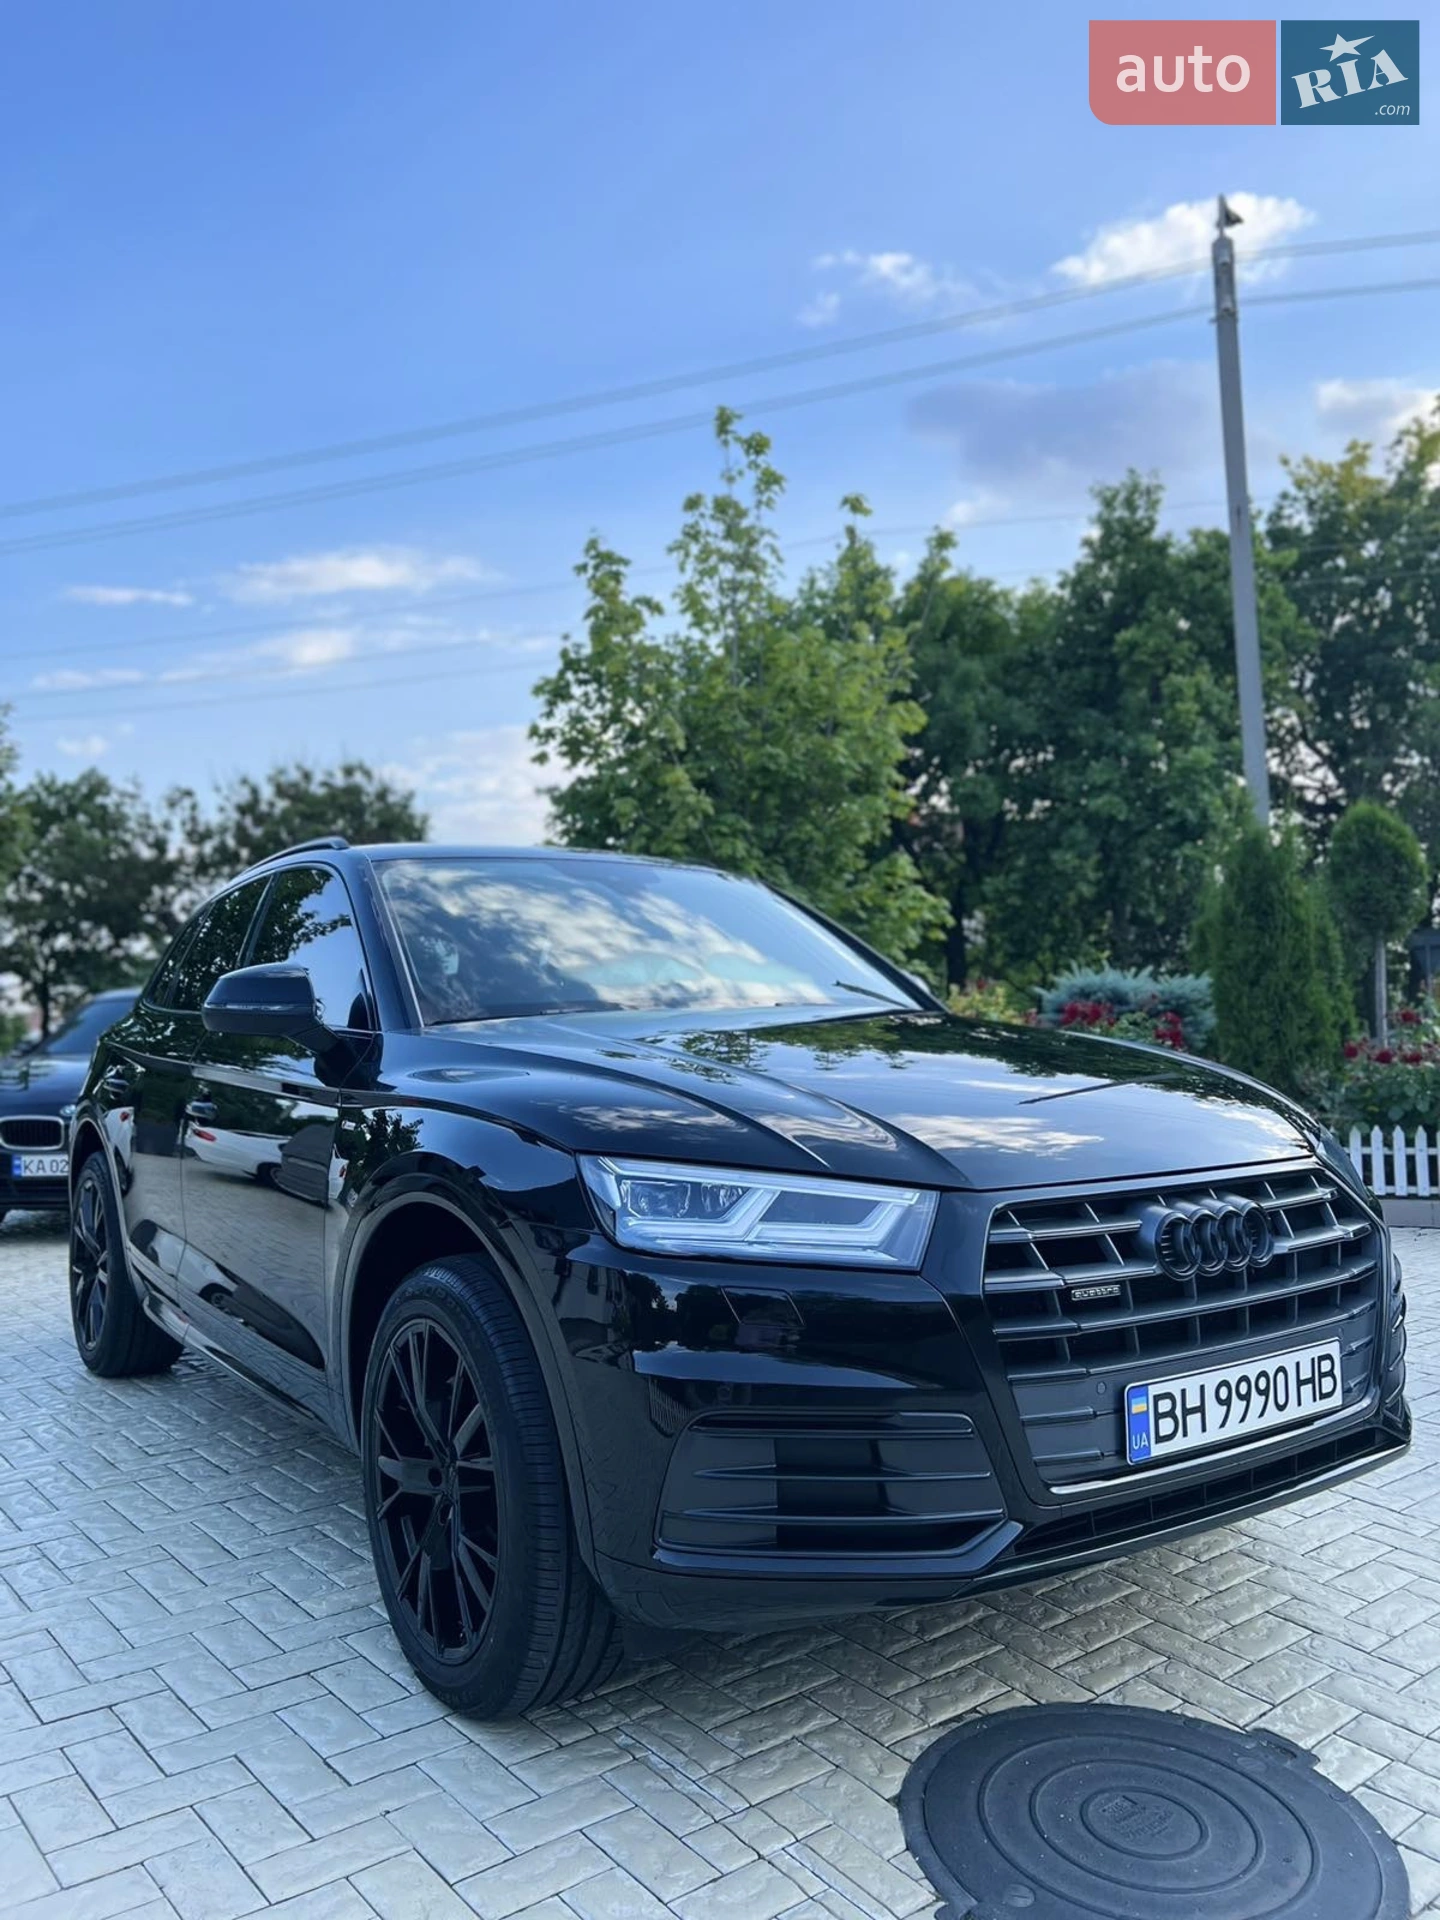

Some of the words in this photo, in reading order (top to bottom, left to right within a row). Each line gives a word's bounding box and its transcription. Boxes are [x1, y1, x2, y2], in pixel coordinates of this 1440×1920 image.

[24, 1159, 47, 1175] KA
[1073, 1286, 1120, 1299] quattro
[1153, 1384, 1207, 1445] BH
[1215, 1365, 1290, 1429] 9990
[1296, 1353, 1338, 1407] HB
[1132, 1431, 1149, 1450] UA
